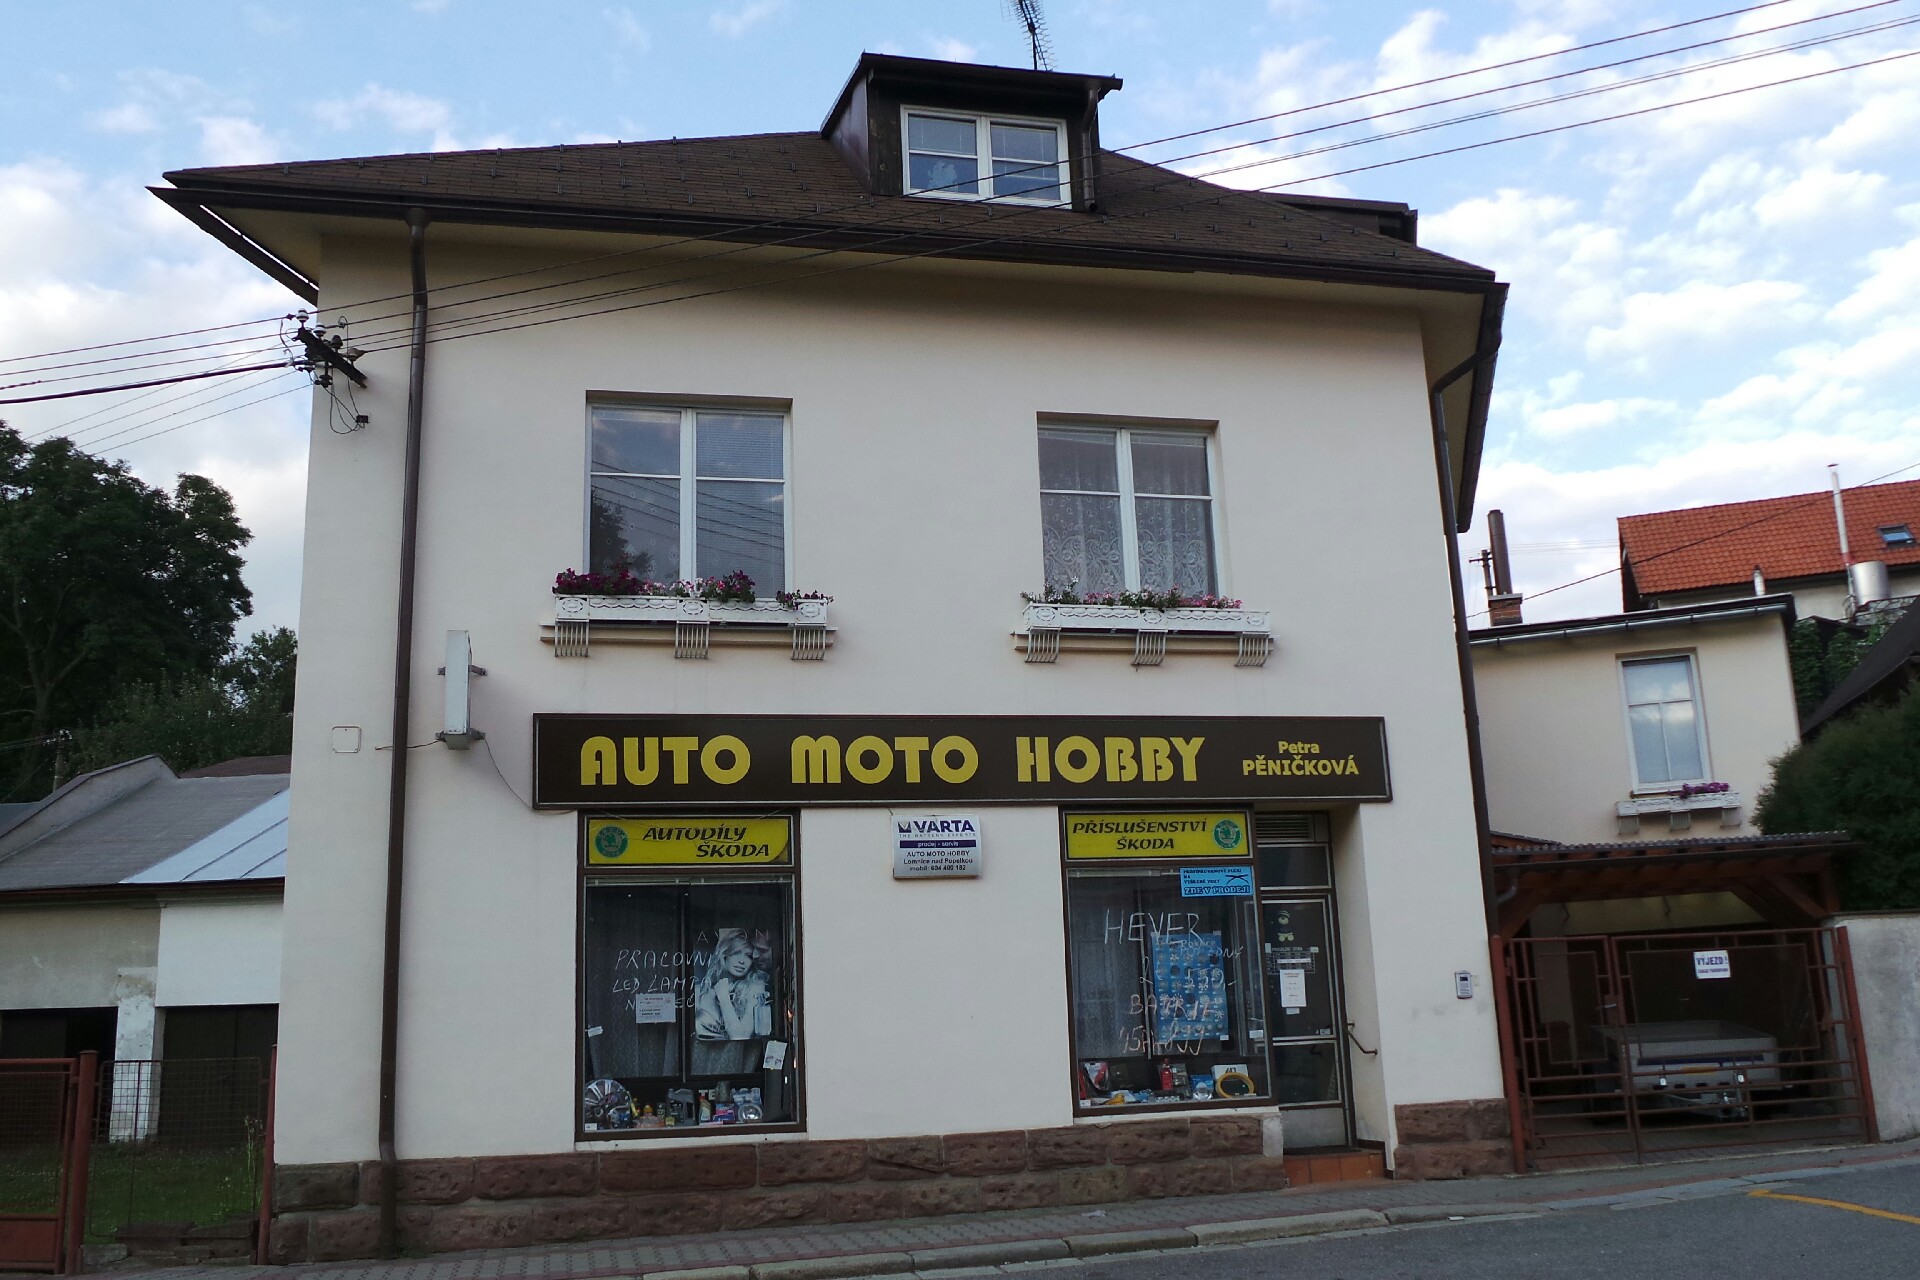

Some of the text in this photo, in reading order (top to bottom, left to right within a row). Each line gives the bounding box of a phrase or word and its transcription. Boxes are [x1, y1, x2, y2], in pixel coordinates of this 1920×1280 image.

[1278, 740, 1320, 755] Petra
[580, 734, 1206, 786] AUTO MOTO HOBBY
[1242, 754, 1360, 776] PĚNIČKOVÁ
[642, 823, 747, 841] AUTODÍLY
[913, 819, 975, 833] VARTA
[1072, 818, 1207, 834] PŘÍSLUŠENSTVÍ
[696, 842, 769, 858] ŠKODA
[1116, 836, 1174, 850] ŠKODA
[944, 857, 973, 865] Popelkou
[1184, 886, 1203, 895] ZDE
[1203, 886, 1211, 894] V
[1104, 908, 1204, 944] HEVER
[612, 977, 640, 994] LED
